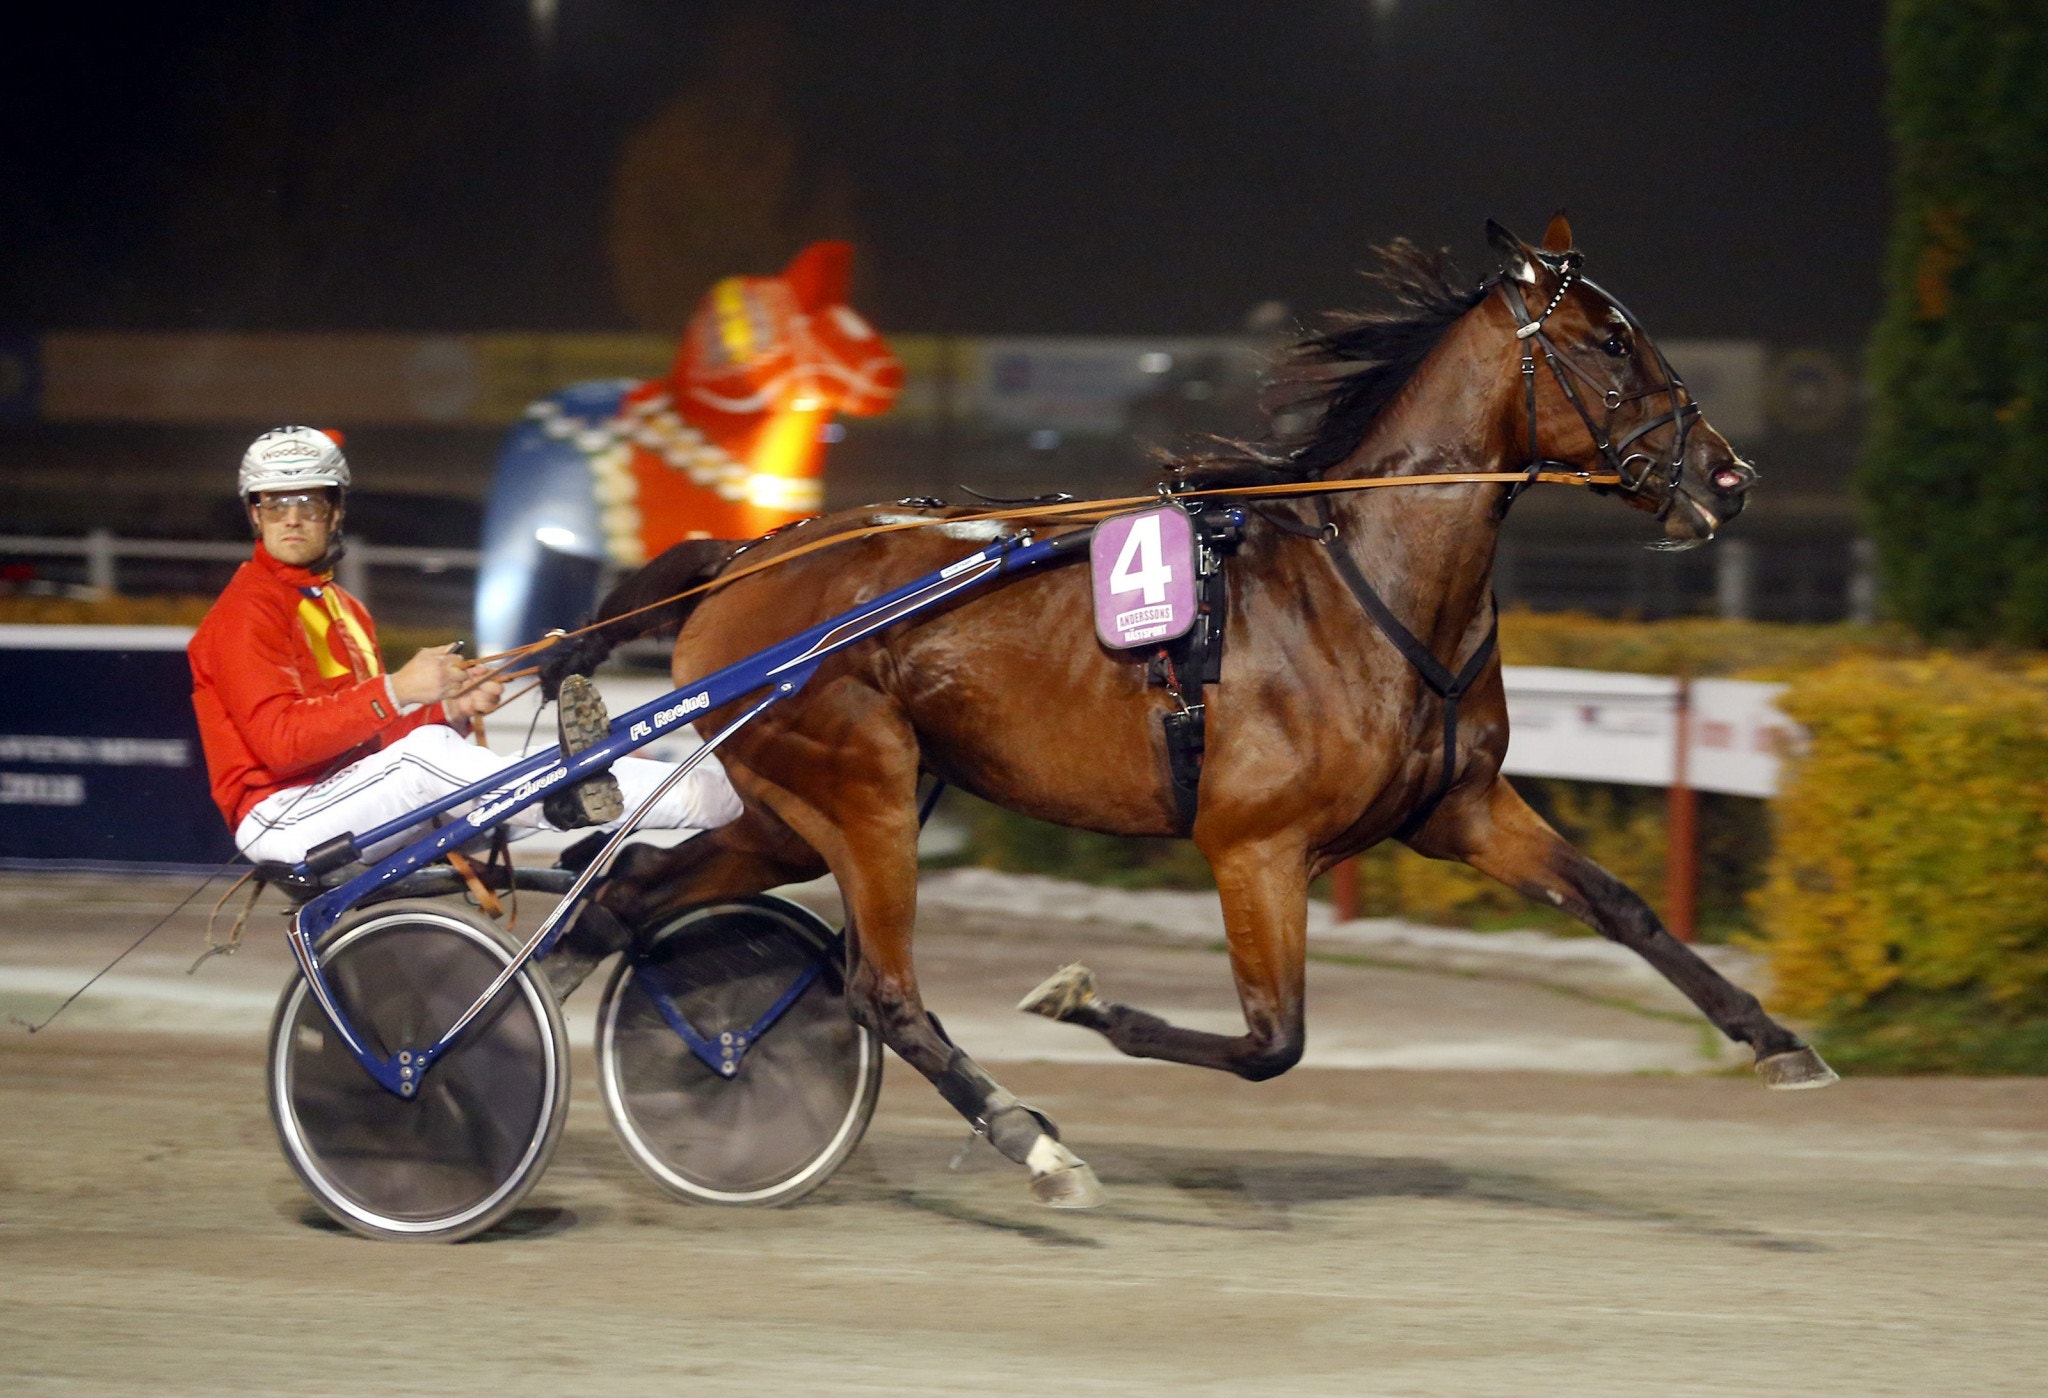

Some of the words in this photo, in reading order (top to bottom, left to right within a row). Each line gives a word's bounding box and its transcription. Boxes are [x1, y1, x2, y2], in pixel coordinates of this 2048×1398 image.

[1110, 515, 1172, 604] 4
[1119, 607, 1171, 627] ANDERSSONS
[631, 724, 652, 741] FL
[655, 691, 709, 728] Racing
[515, 766, 568, 799] Chrono
